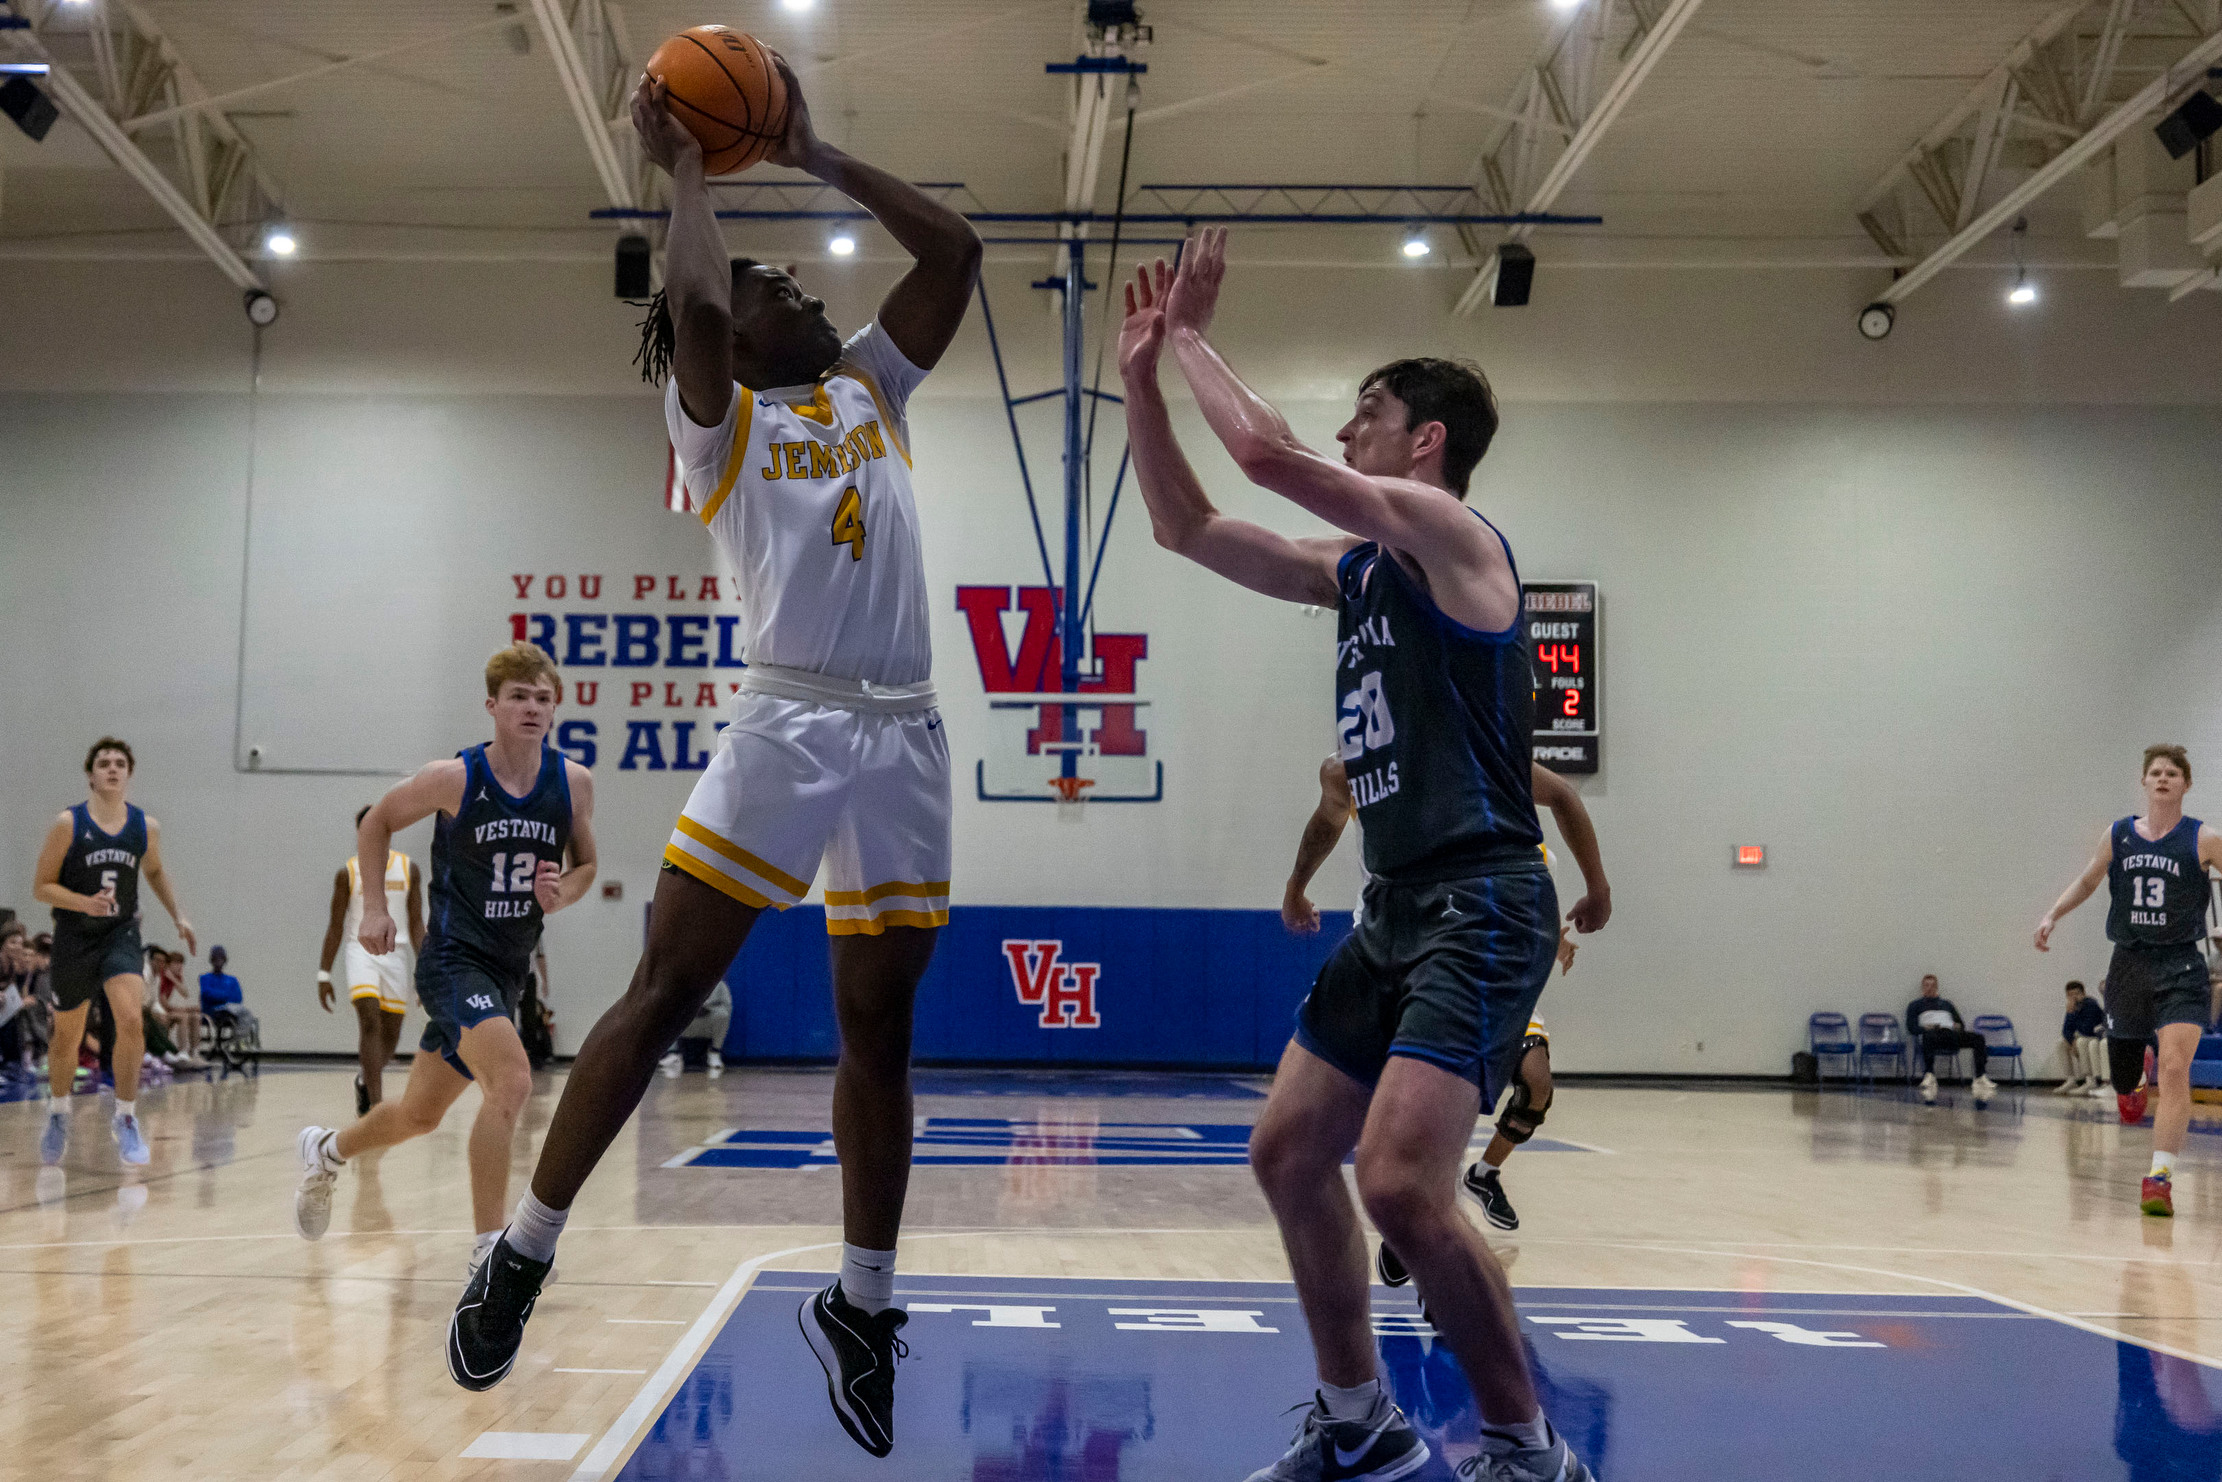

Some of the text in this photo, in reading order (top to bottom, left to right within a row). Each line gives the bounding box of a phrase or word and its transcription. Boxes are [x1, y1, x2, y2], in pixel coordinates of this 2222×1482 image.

[762, 420, 887, 481] JEMISON
[831, 485, 867, 562] 4
[512, 574, 741, 601] YOU PLA
[1531, 622, 1579, 639] GUEST
[1538, 644, 1580, 673] 44
[1563, 689, 1580, 716] 2
[546, 720, 598, 769] S
[1348, 761, 1400, 809] HILLS
[475, 818, 557, 846] VESTAVIA
[85, 848, 136, 868] VESTAVIA
[491, 852, 536, 892] 12
[2122, 854, 2180, 877] VESTAVIA
[2132, 876, 2165, 908] 13
[484, 900, 532, 918] HILLS
[2130, 911, 2167, 926] HILLS
[1002, 940, 1101, 1029] VH
[466, 994, 494, 1010] VH
